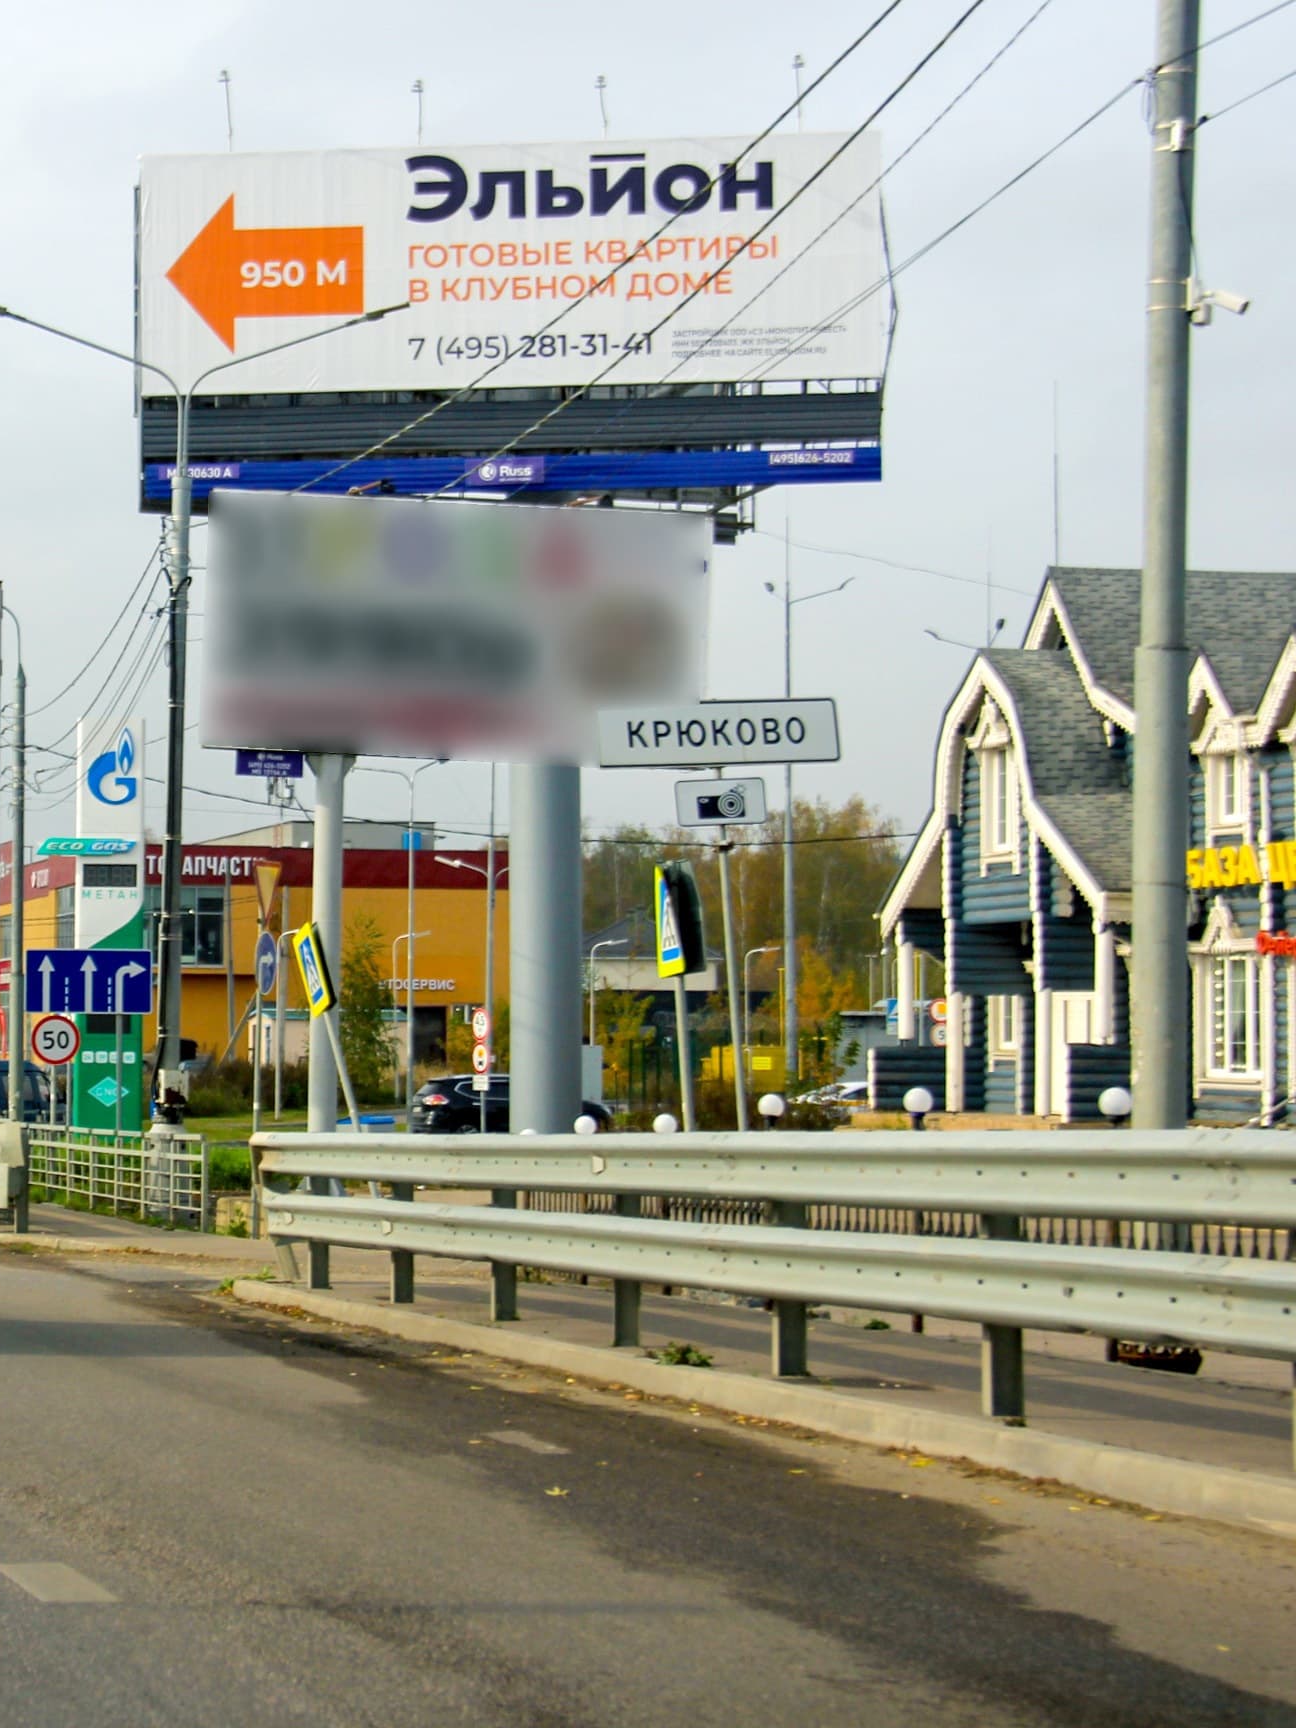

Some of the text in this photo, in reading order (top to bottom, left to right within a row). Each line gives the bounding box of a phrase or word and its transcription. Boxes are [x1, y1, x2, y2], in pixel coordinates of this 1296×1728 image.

[408, 235, 778, 269] ГОТОВЫЕ КВАРТИРЫ
[240, 260, 305, 288] 950
[409, 270, 734, 303] В КЛУБНОМ ДОМЕ
[409, 333, 653, 365] 7 (495) 281-31-41
[500, 465, 532, 477] Russ
[627, 716, 805, 748] КРЮКОВО
[46, 841, 84, 851] ECO
[82, 890, 138, 900] МЕТАН
[42, 1030, 70, 1050] 50
